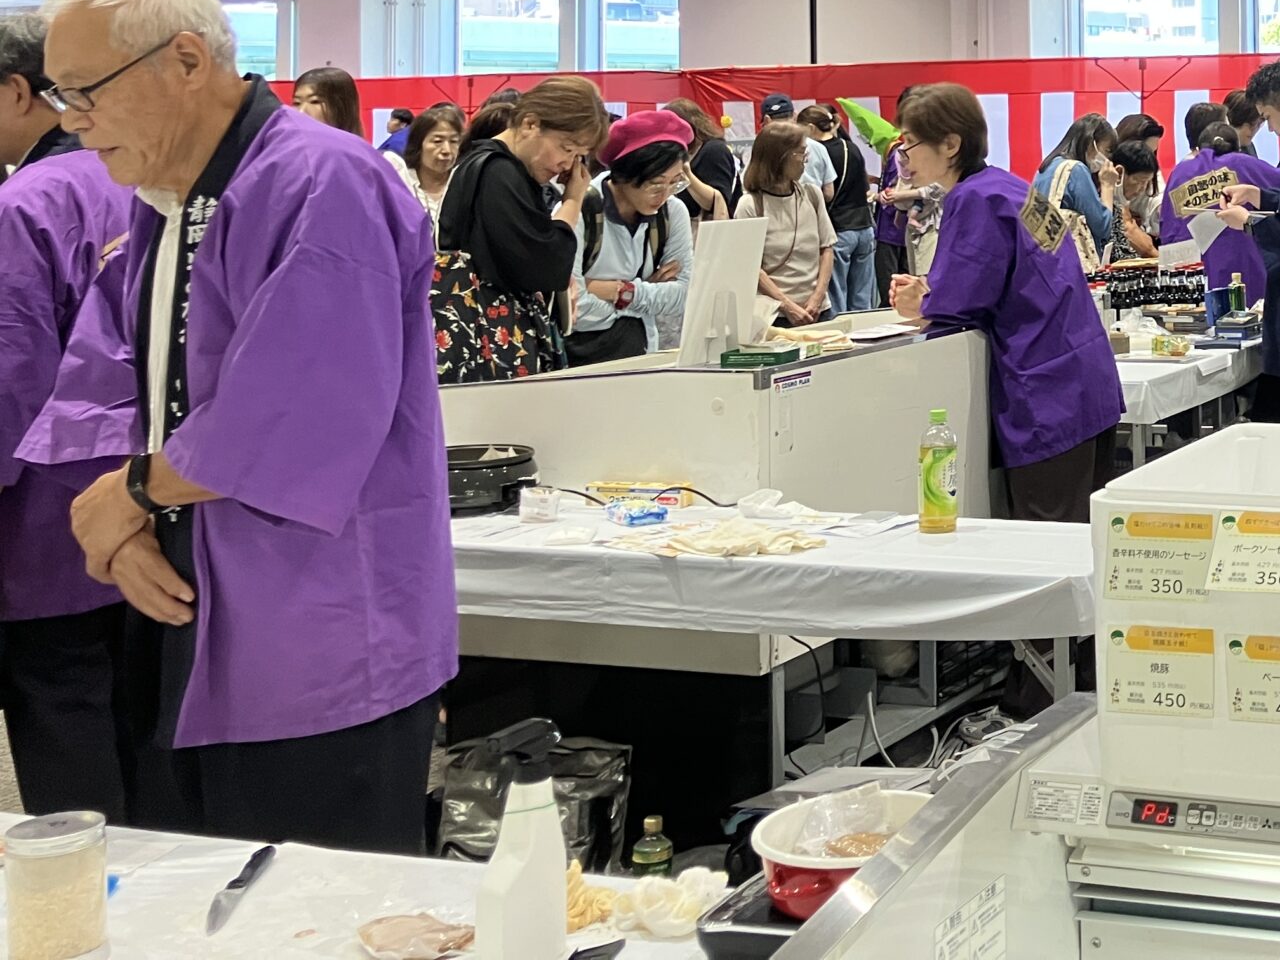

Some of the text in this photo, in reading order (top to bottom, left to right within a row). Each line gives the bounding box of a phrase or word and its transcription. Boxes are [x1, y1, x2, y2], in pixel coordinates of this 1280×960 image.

[1112, 548, 1207, 561] 香辛料不使用のソーセージ
[1151, 578, 1183, 594] 350
[1150, 663, 1170, 674] 焼豚
[1153, 692, 1186, 708] 450
